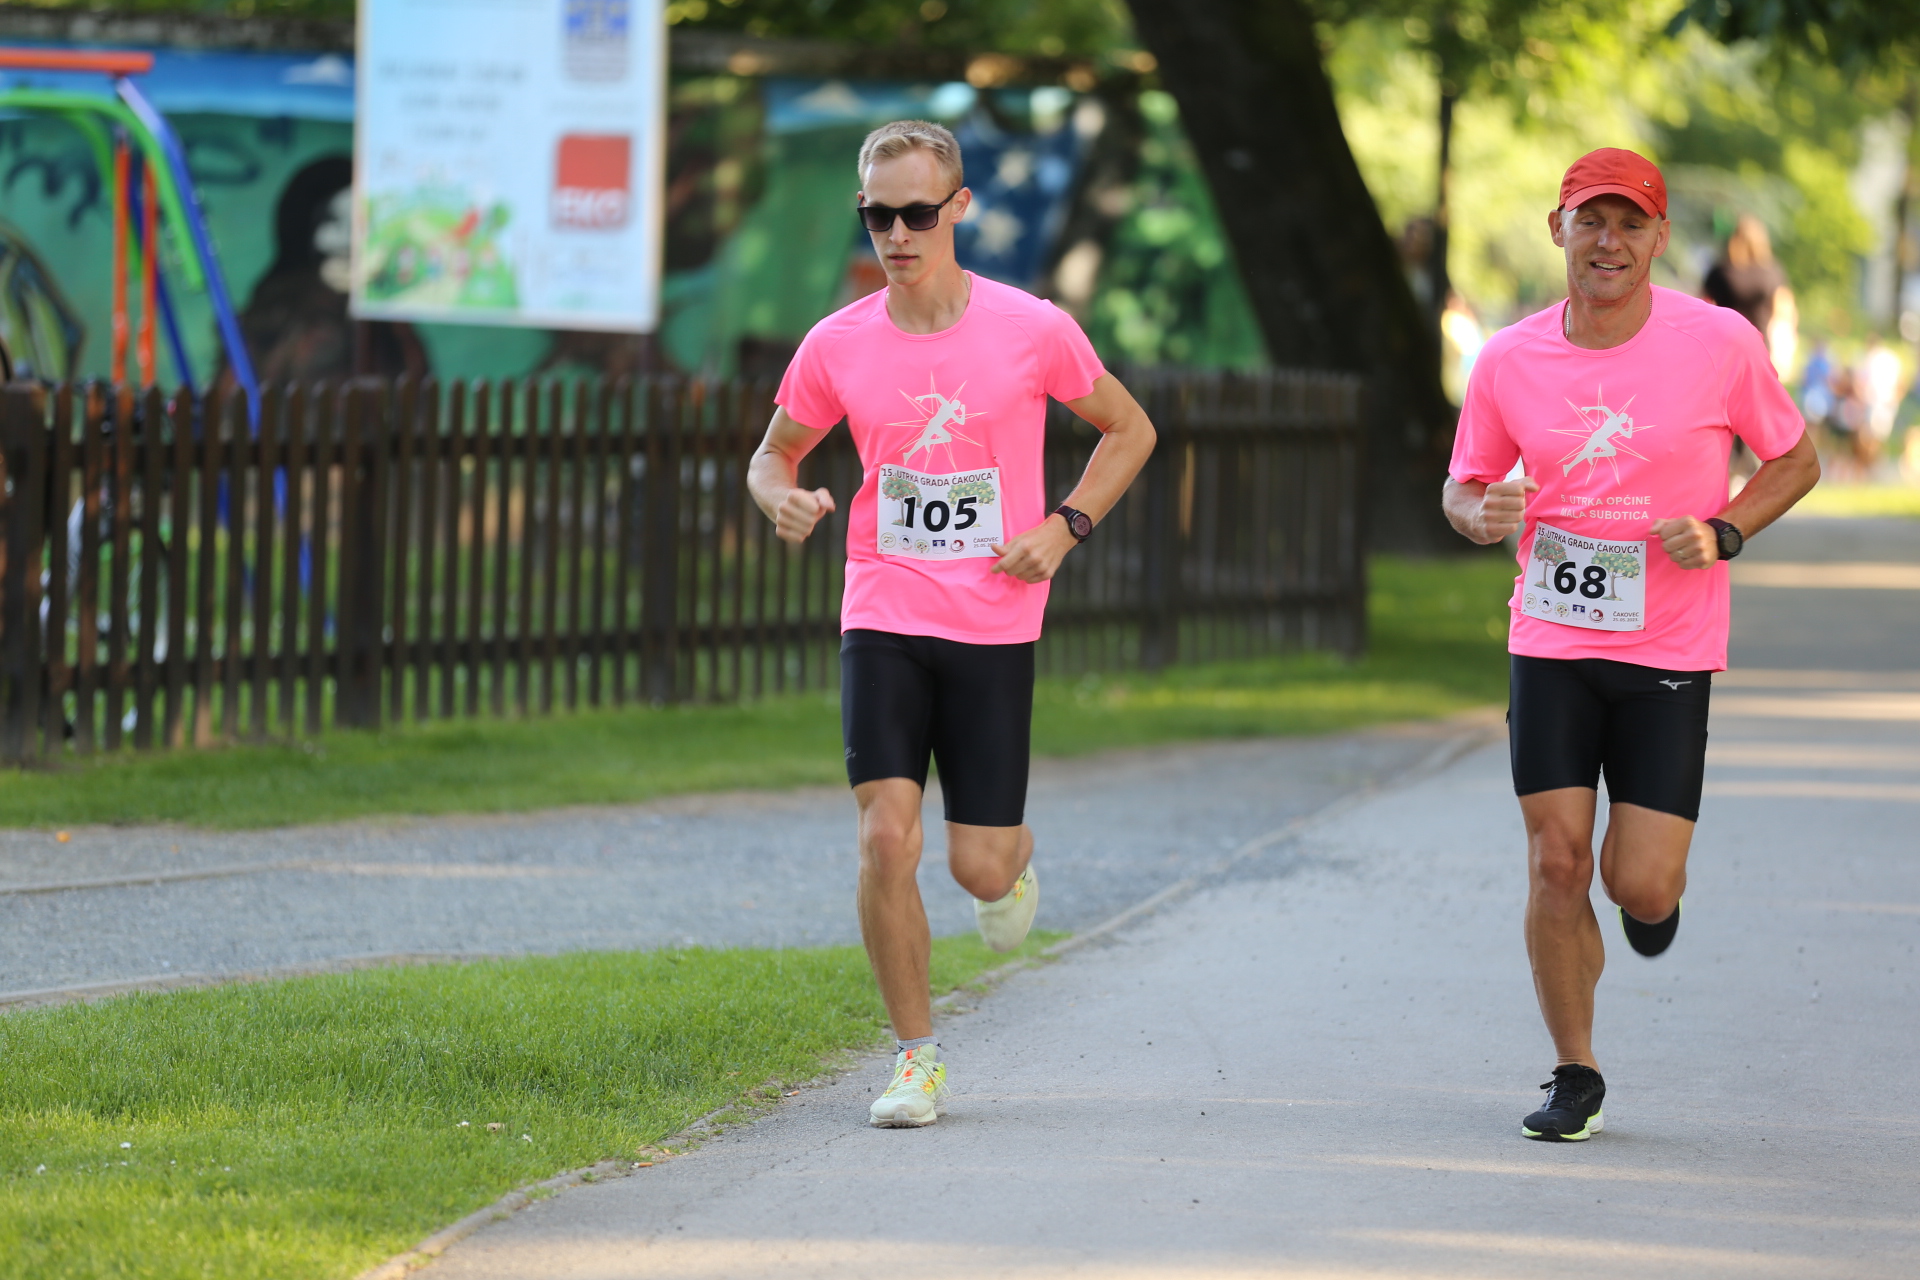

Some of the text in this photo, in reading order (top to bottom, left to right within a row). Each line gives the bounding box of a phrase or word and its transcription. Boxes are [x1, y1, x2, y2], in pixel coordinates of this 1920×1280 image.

[882, 468, 993, 487] 15. UTRKA GRADA ČAKOVCA
[1560, 494, 1652, 506] 5. UTRKA OPĆINE
[904, 496, 978, 533] 105
[1560, 507, 1650, 521] MALA SUBOTICA
[1537, 526, 1639, 554] 15. UTRKA GRADA ČAKOVCA
[1554, 561, 1607, 600] 68
